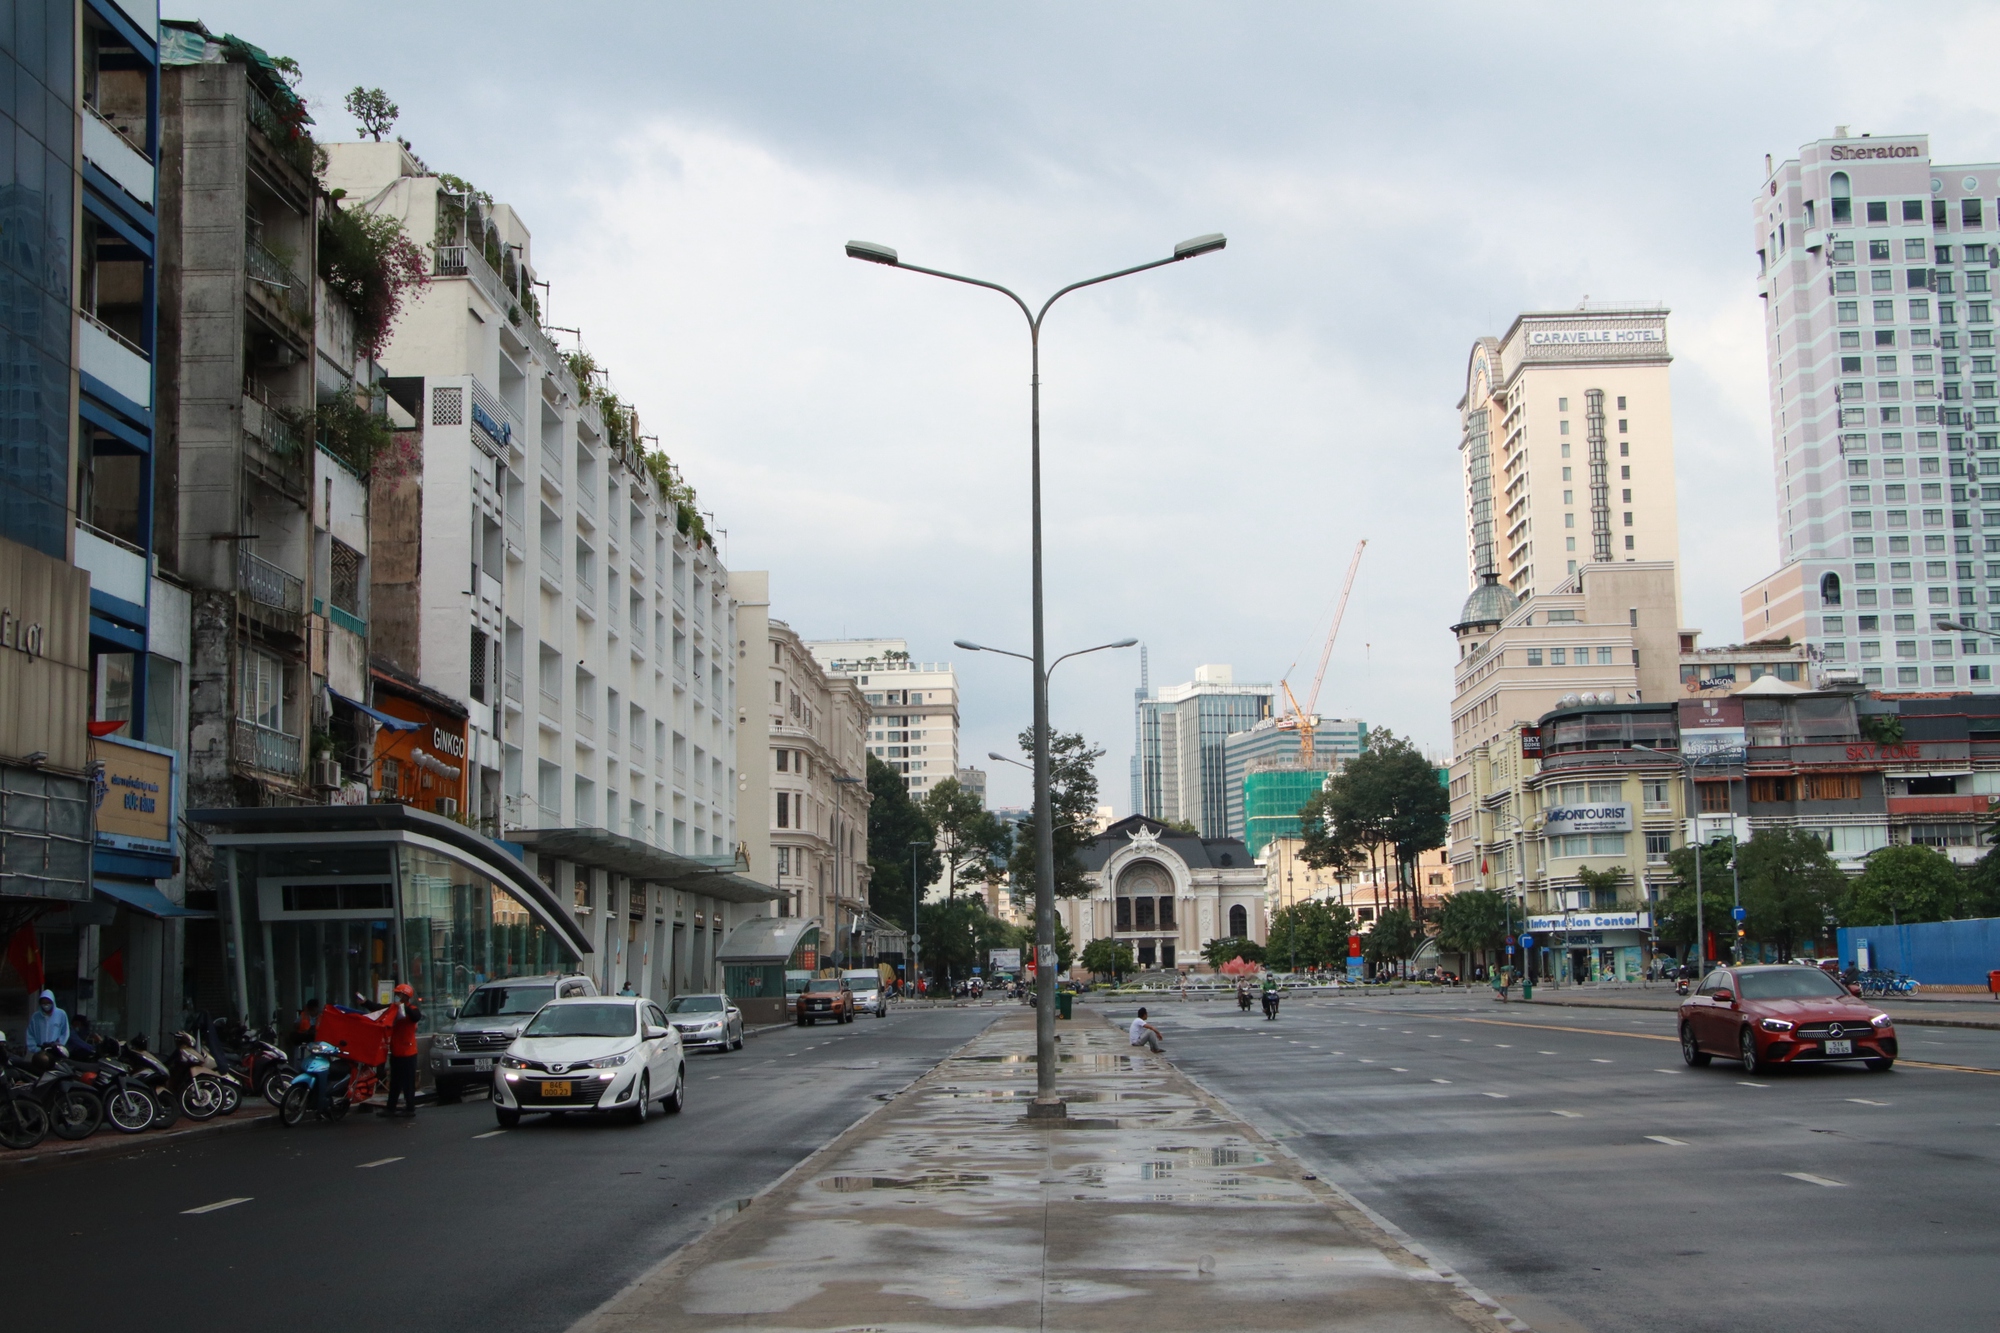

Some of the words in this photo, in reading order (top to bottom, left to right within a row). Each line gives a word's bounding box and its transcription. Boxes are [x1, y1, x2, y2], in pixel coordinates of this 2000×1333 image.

[1830, 144, 1920, 161] Sheraton
[1533, 331, 1610, 344] CARAVELLE
[1616, 330, 1660, 342] HOTEL
[0, 606, 11, 647] Ê
[16, 620, 45, 664] LỢI
[1705, 678, 1733, 686] SAIGON
[433, 727, 465, 759] GINKGO
[1846, 744, 1876, 760] SKY
[1881, 744, 1921, 759] ZONE
[1594, 916, 1637, 927] Center
[549, 1081, 563, 1089] 84E
